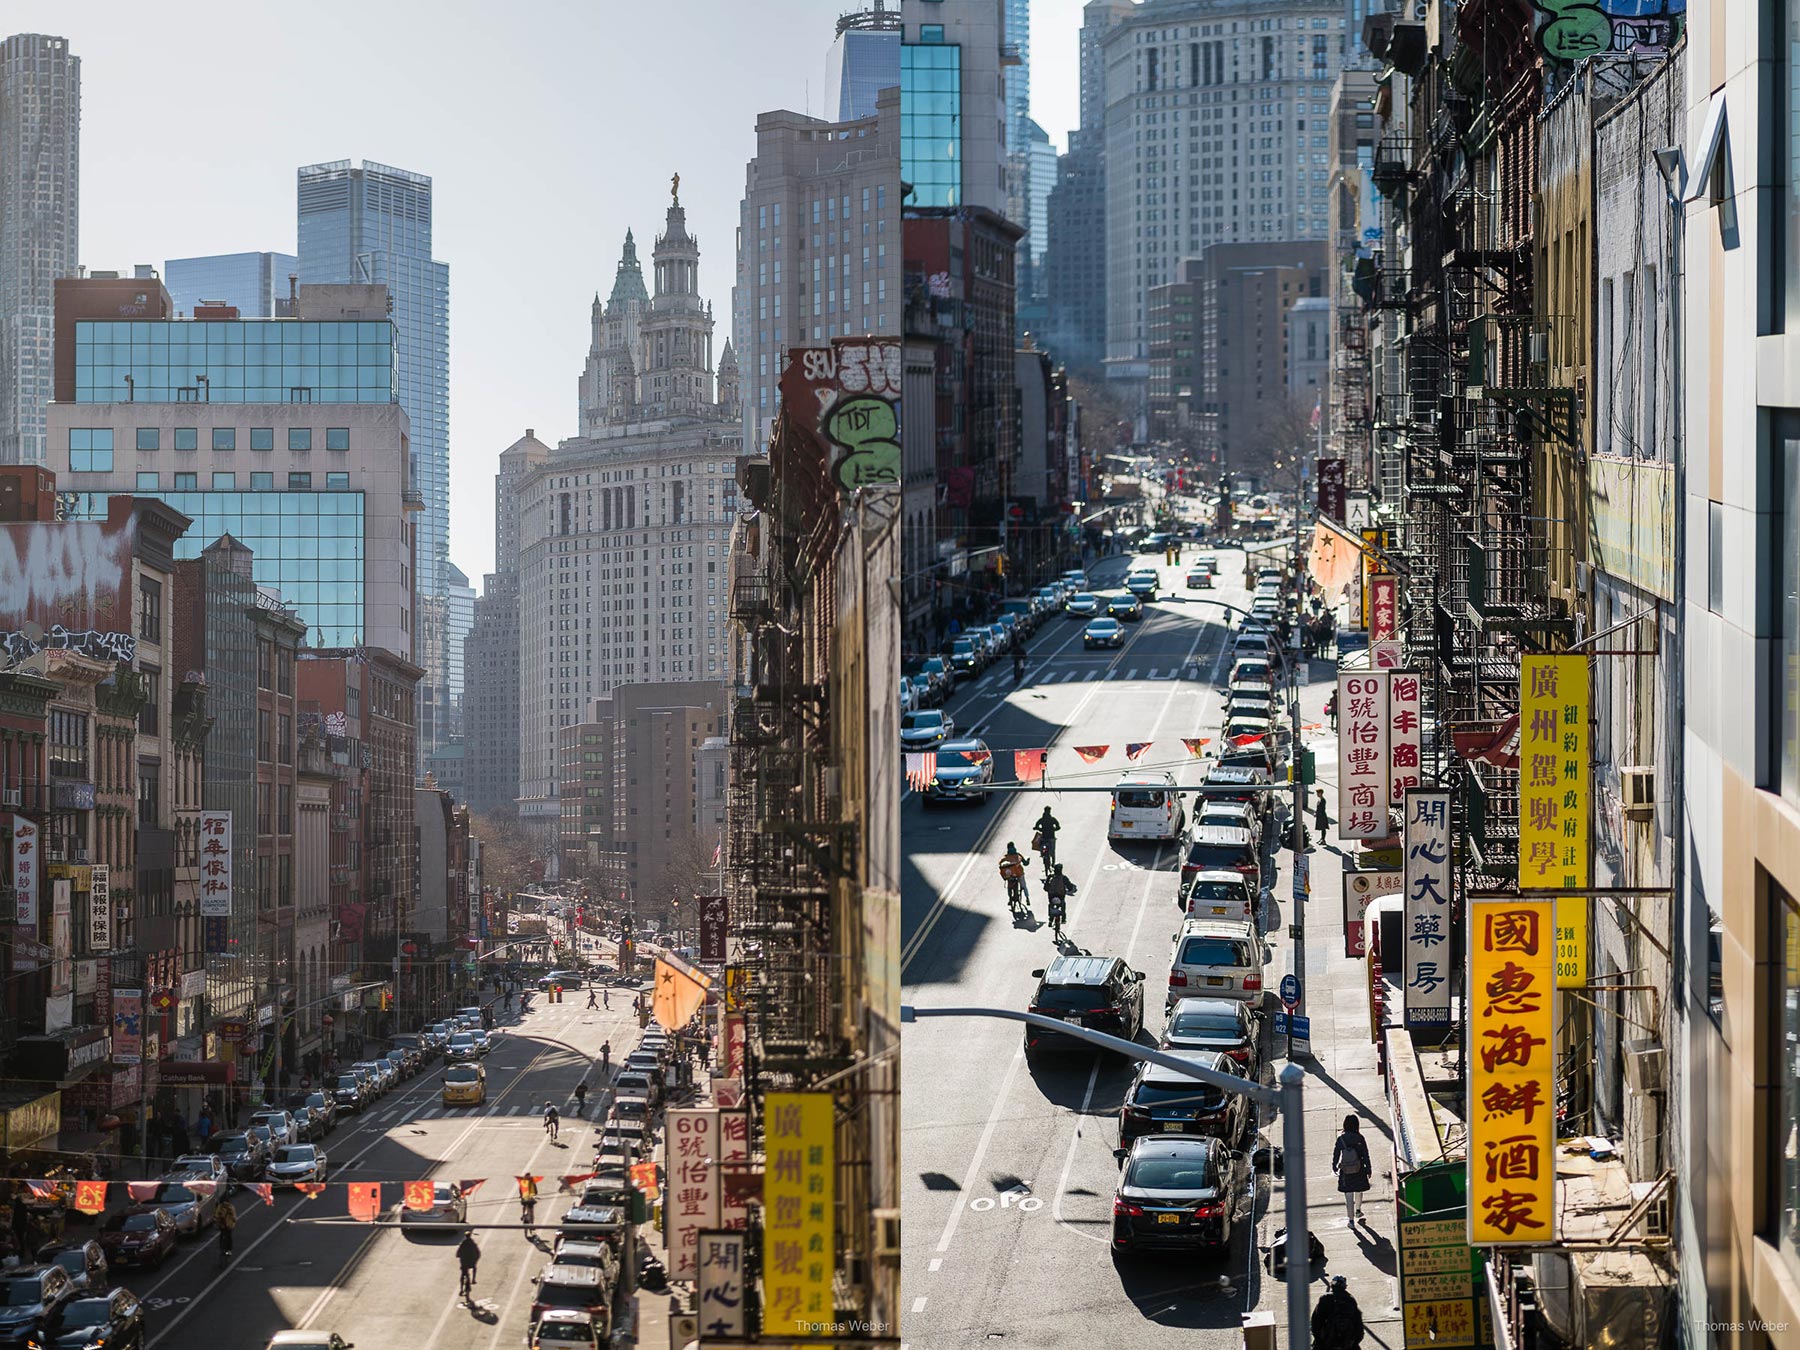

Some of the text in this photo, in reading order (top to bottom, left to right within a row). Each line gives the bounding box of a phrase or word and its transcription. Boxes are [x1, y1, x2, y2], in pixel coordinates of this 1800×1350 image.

[1347, 678, 1379, 834] 60號怡豐商場
[1528, 665, 1558, 888] 廣州駕駛學
[1408, 799, 1447, 994] 開心大藥房
[162, 1074, 186, 1083] Cathay
